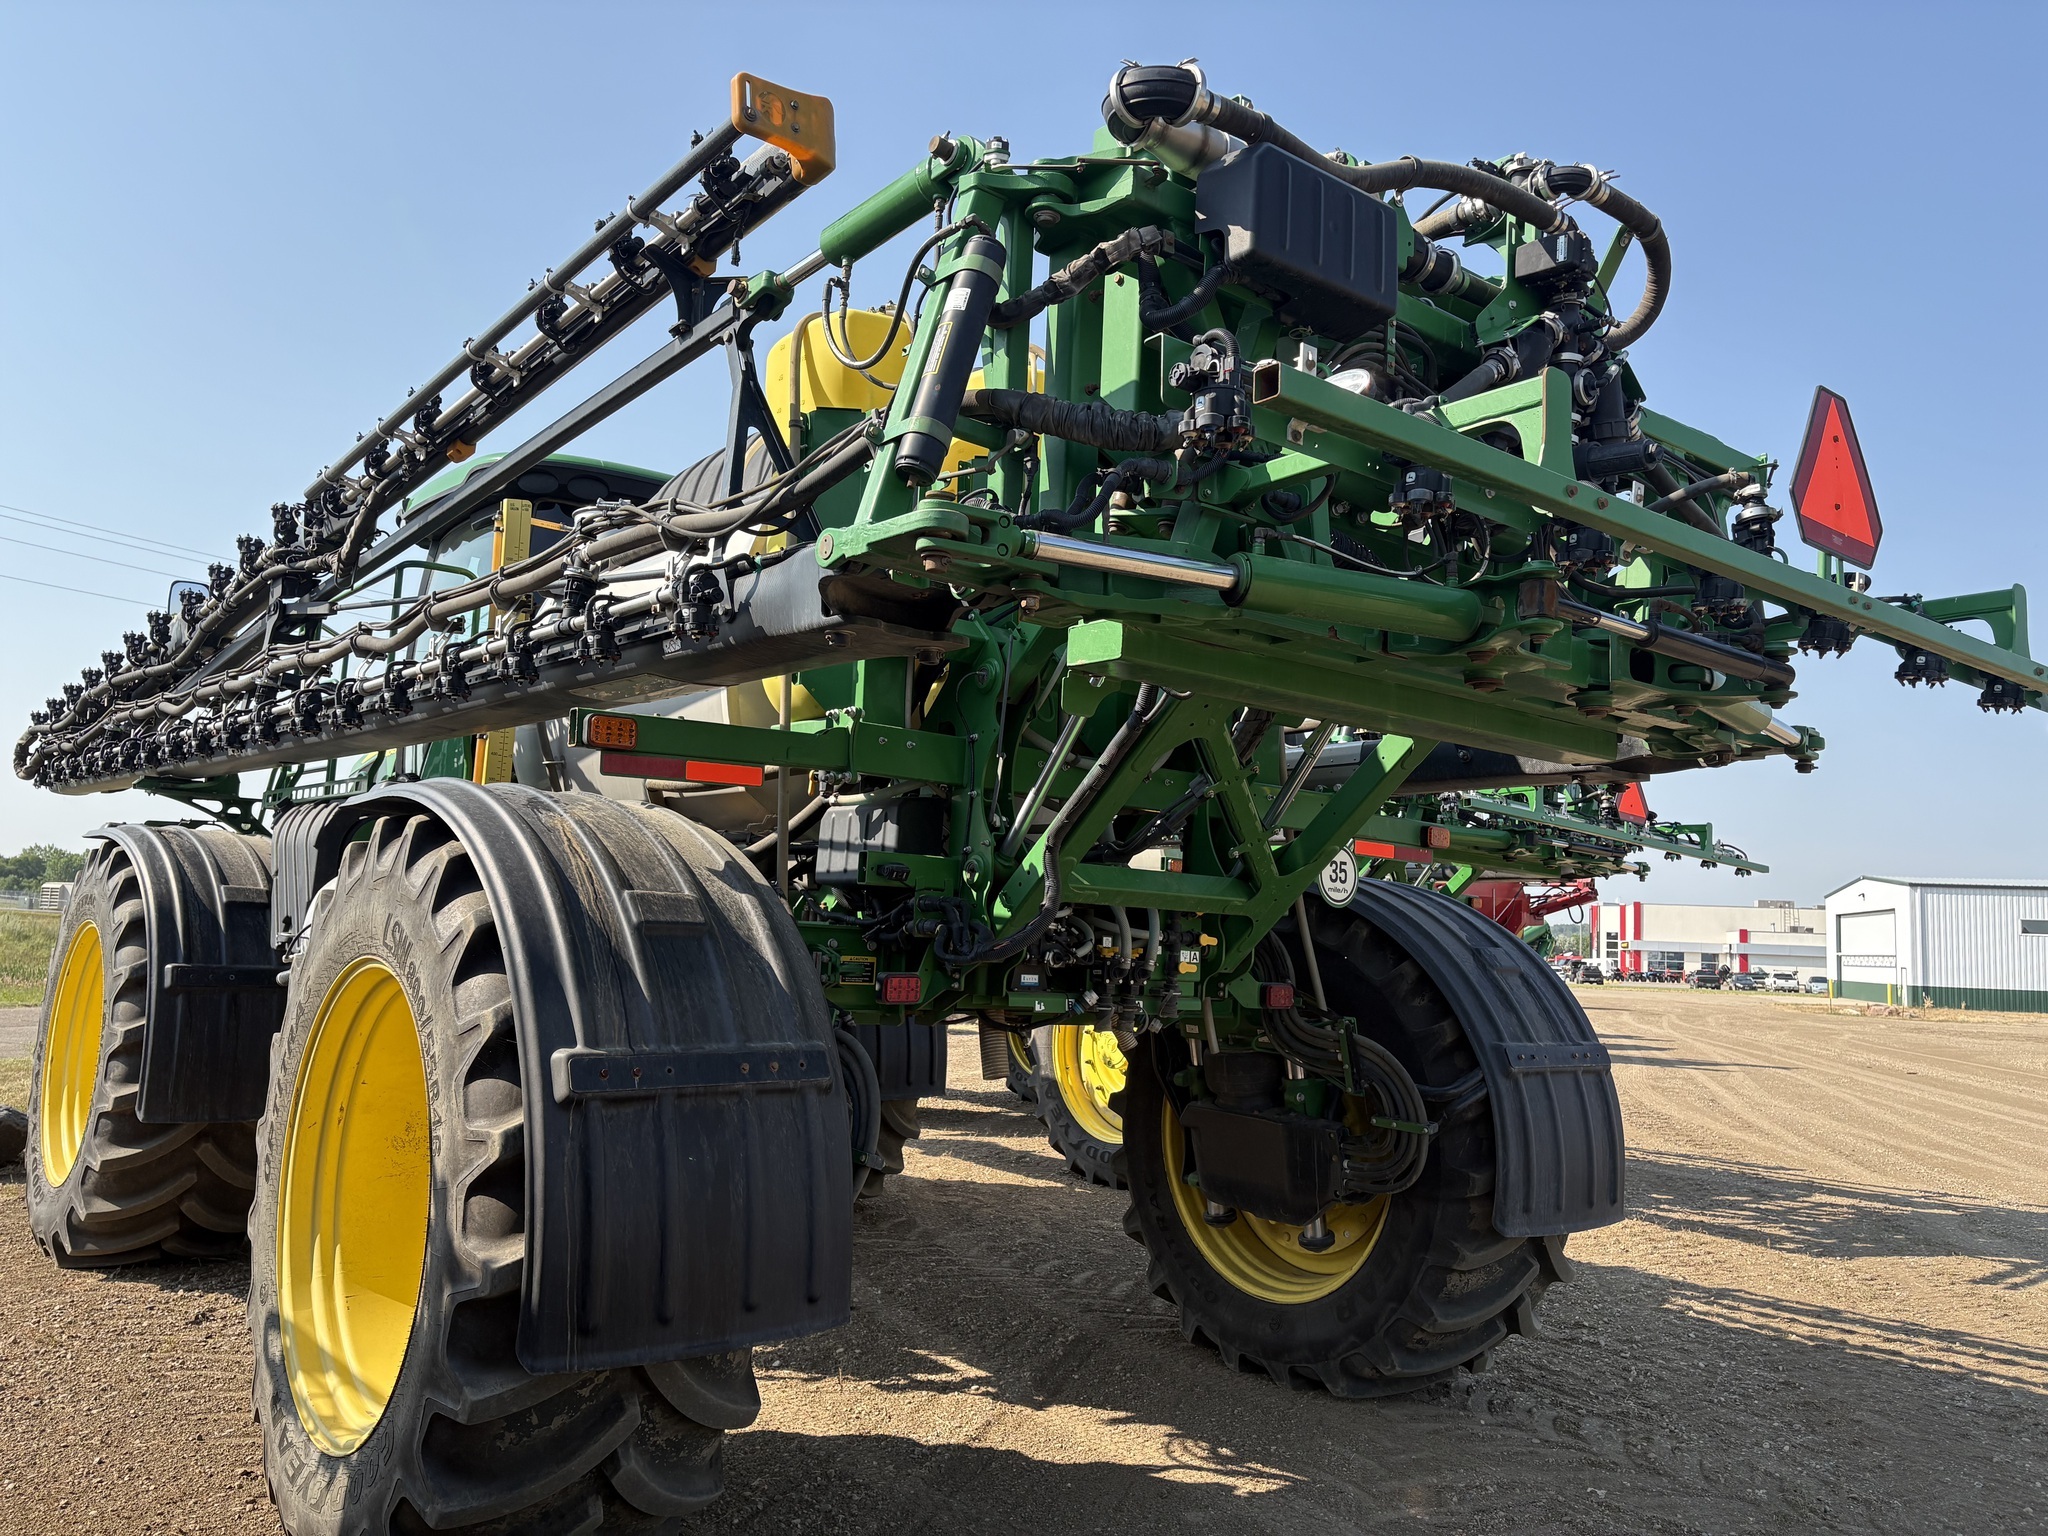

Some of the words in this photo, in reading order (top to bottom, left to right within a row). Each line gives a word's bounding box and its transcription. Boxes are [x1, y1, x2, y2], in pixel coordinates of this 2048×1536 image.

[1329, 860, 1348, 884] 35
[1327, 886, 1349, 894] mile/h
[1191, 952, 1199, 961] A
[270, 1391, 395, 1515] GOODYEAR
